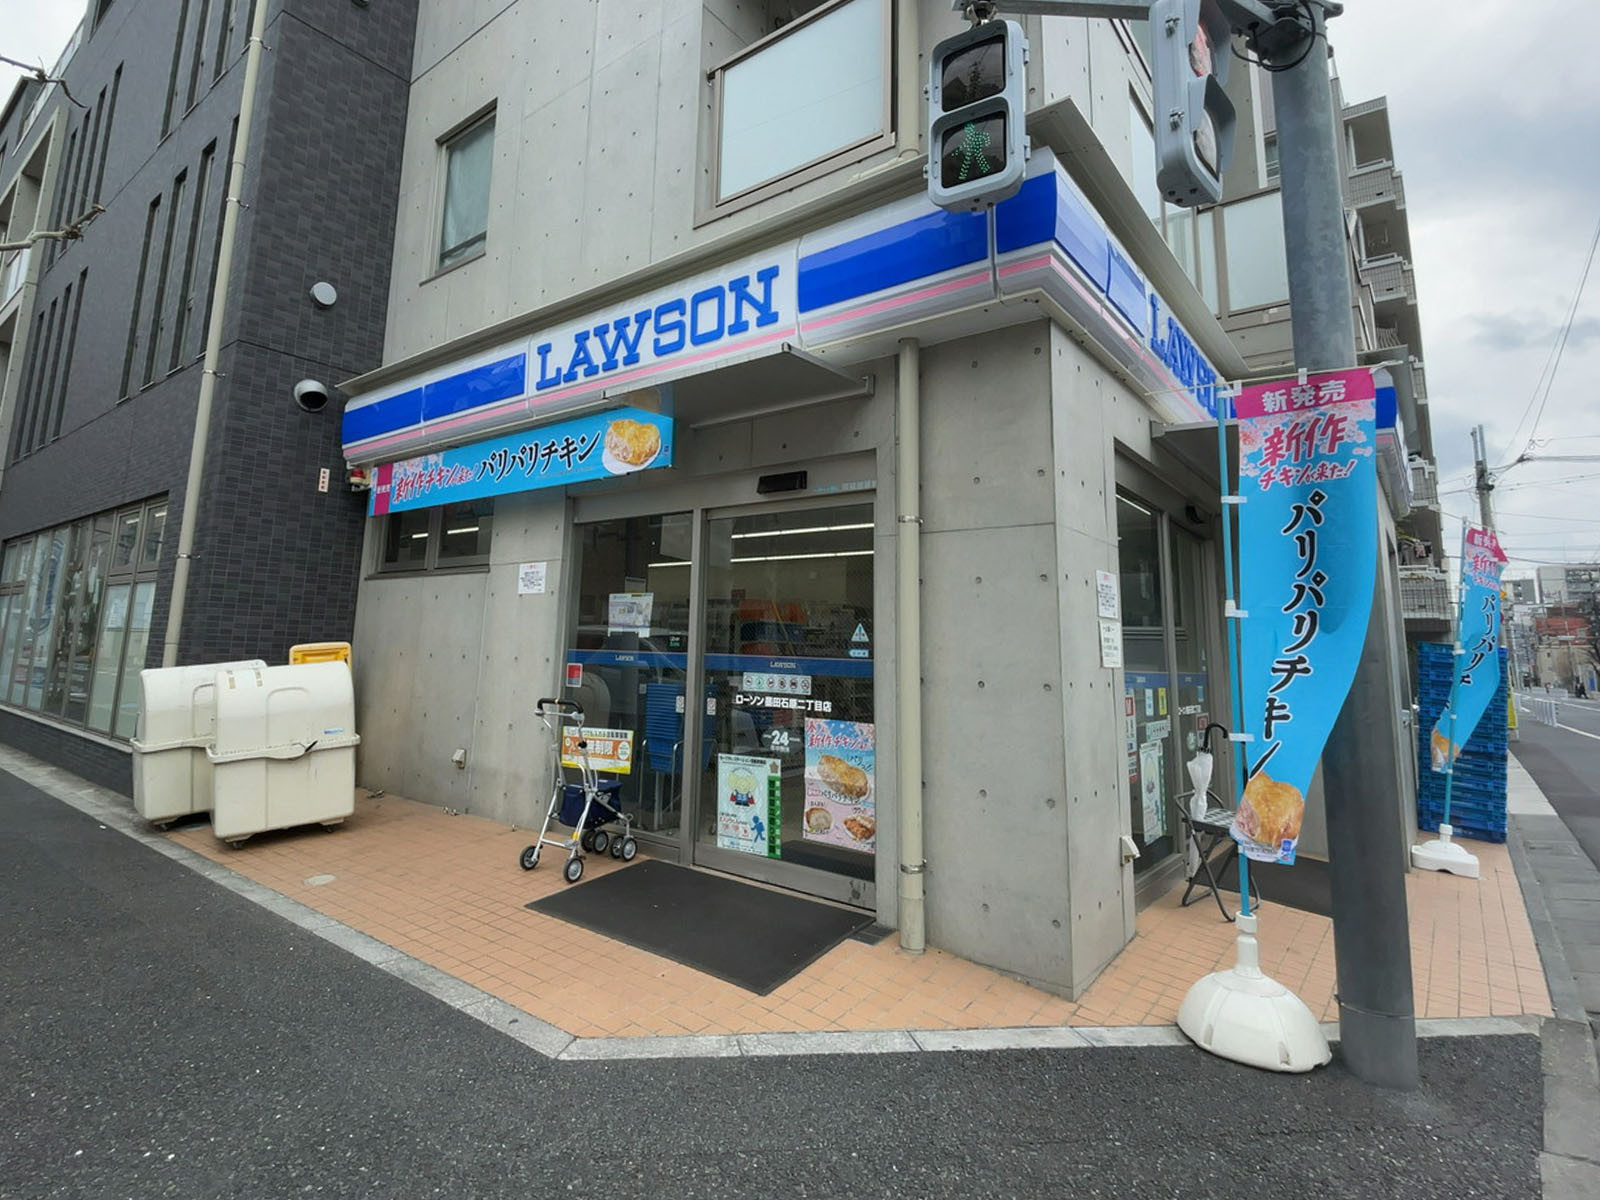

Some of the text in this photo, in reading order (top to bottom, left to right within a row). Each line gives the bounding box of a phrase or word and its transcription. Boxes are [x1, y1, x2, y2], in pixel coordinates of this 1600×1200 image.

[535, 265, 780, 390] LAWSON
[1262, 380, 1346, 412] 新発売
[476, 431, 601, 483] パリパリチキン
[1258, 412, 1348, 468] 新作
